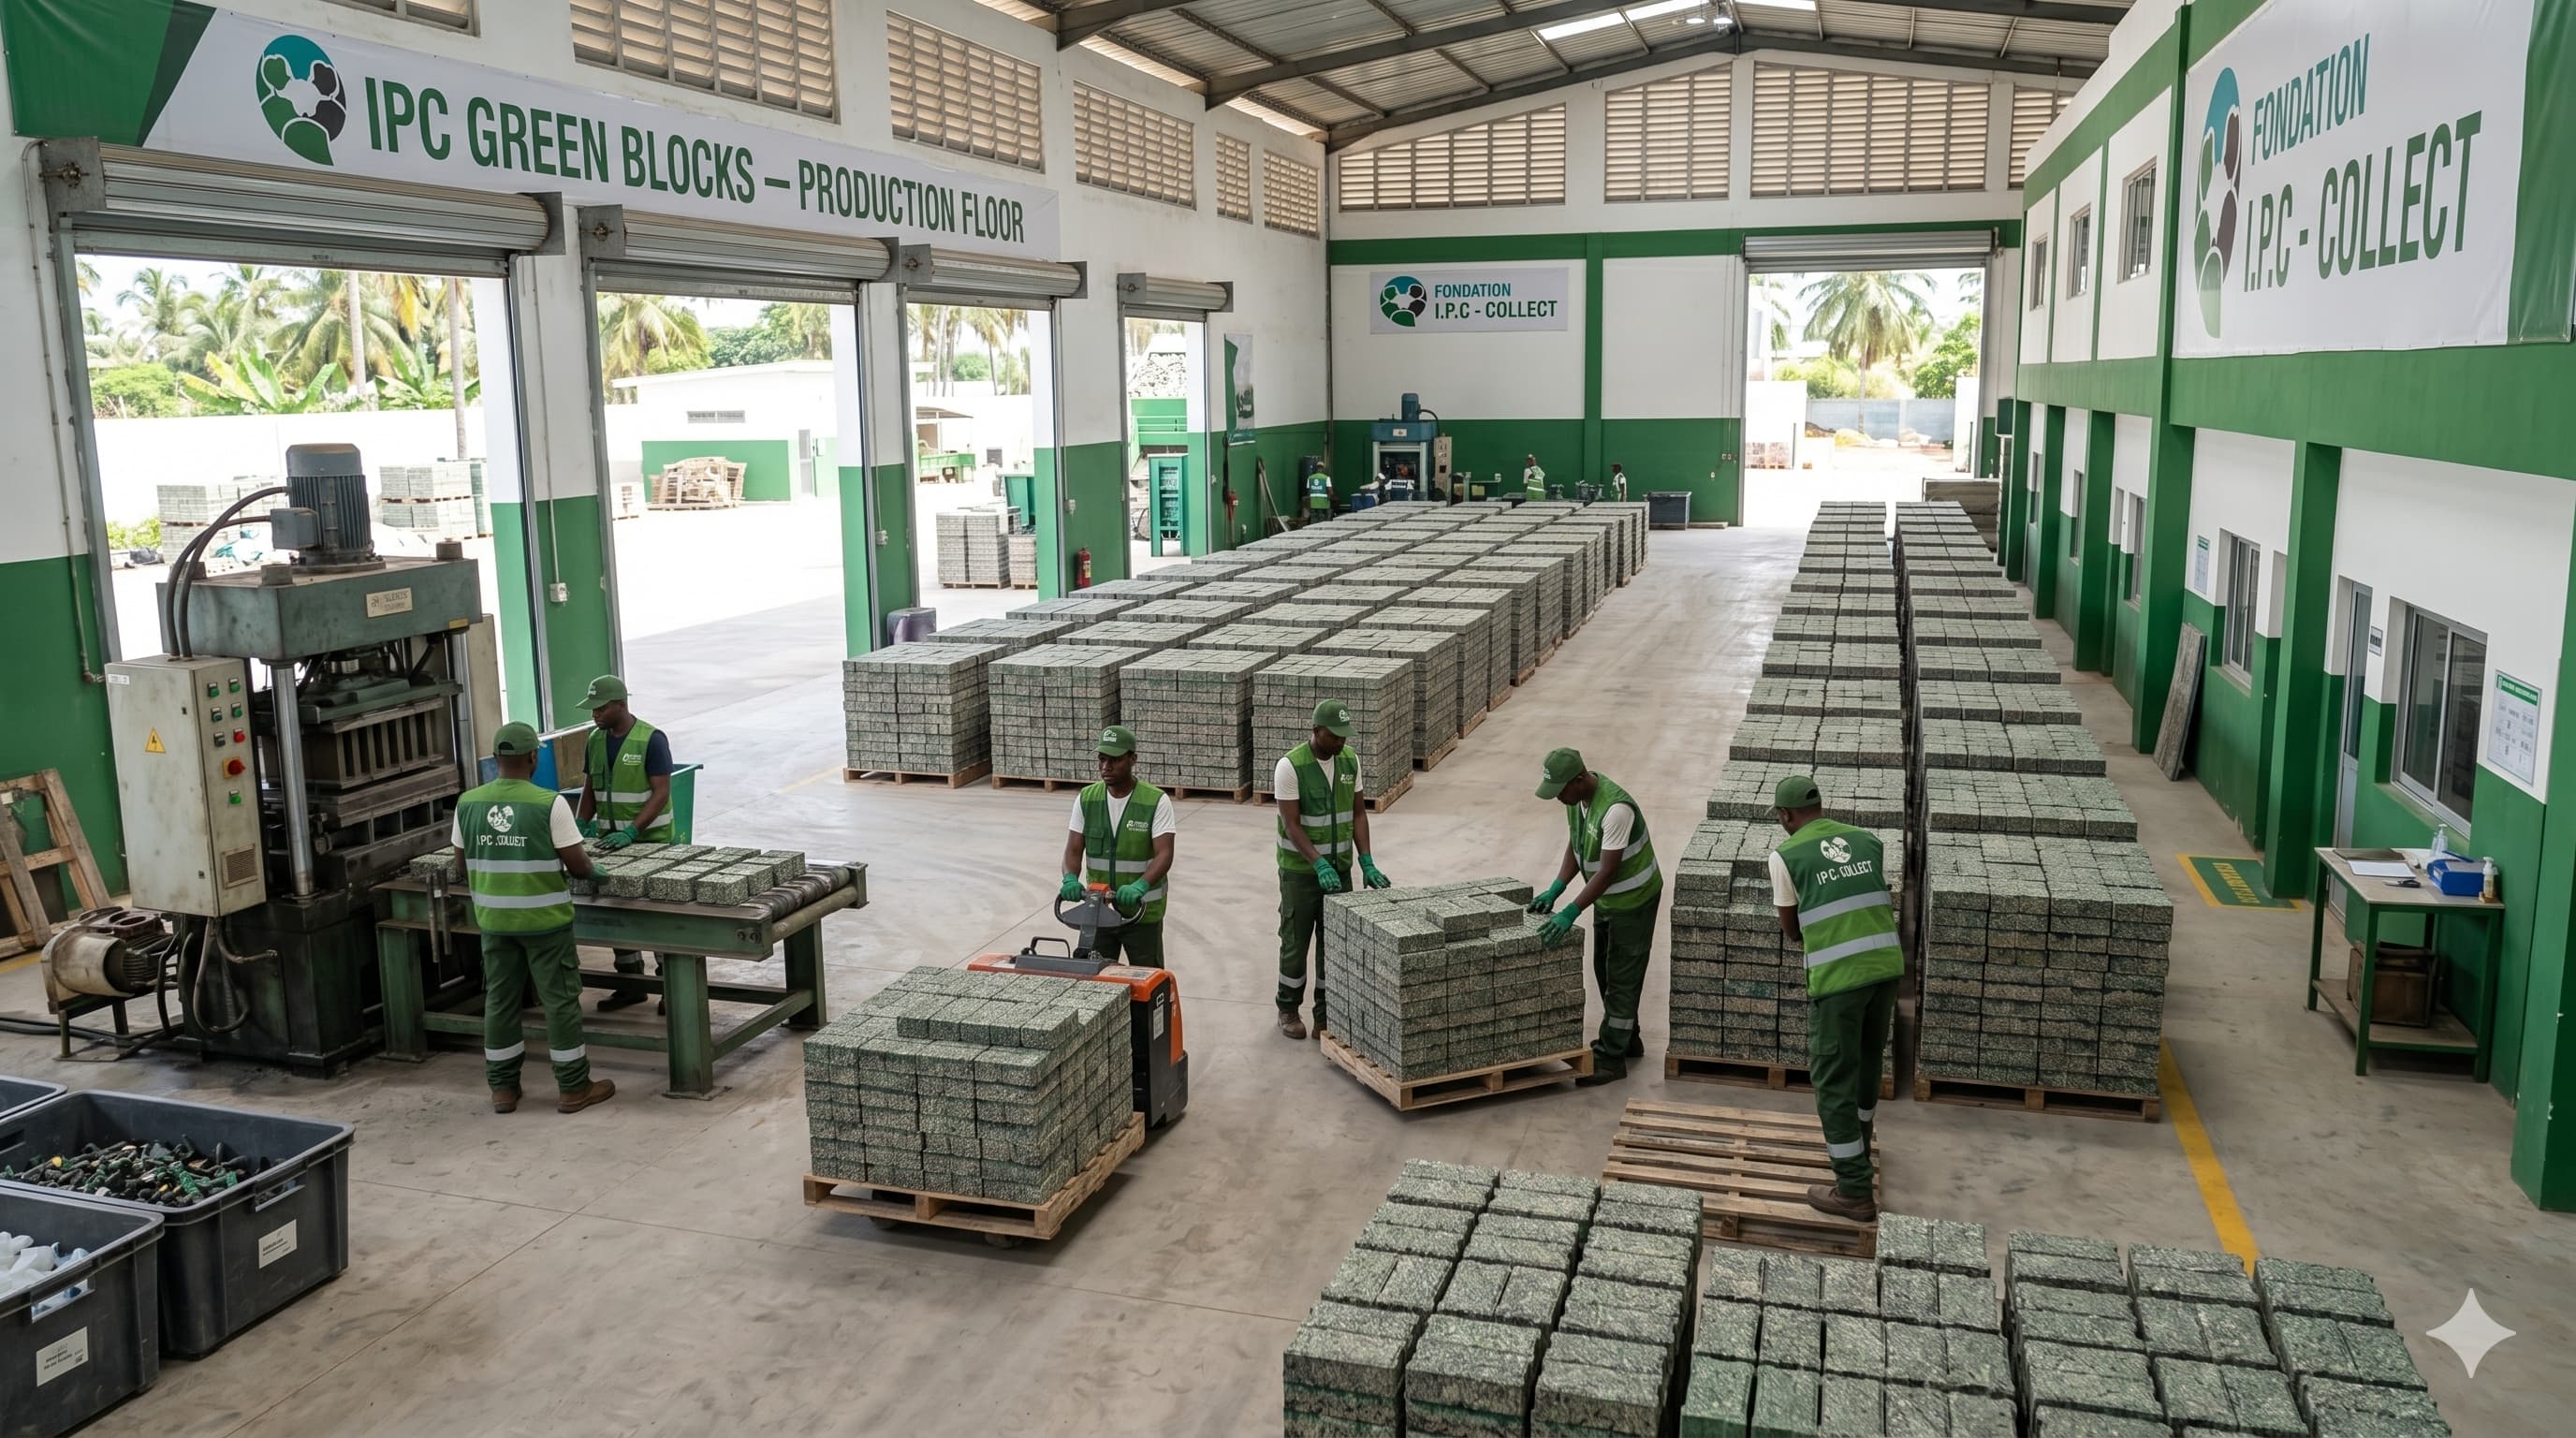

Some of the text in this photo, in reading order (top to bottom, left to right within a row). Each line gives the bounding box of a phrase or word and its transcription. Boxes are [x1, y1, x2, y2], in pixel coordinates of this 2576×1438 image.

[365, 76, 451, 161] IPC
[467, 96, 609, 183] GREEN
[622, 125, 755, 204] BLOCKS
[798, 158, 956, 232] PRODUCTION
[961, 191, 1025, 243] FLOOR
[2251, 33, 2370, 166] FONDATION
[2244, 183, 2293, 292] I.P.C
[2318, 110, 2482, 280] COLLECT
[1434, 283, 1512, 299] FONDATION
[1435, 301, 1471, 319] I.P.C
[1486, 300, 1559, 318] COLLECT
